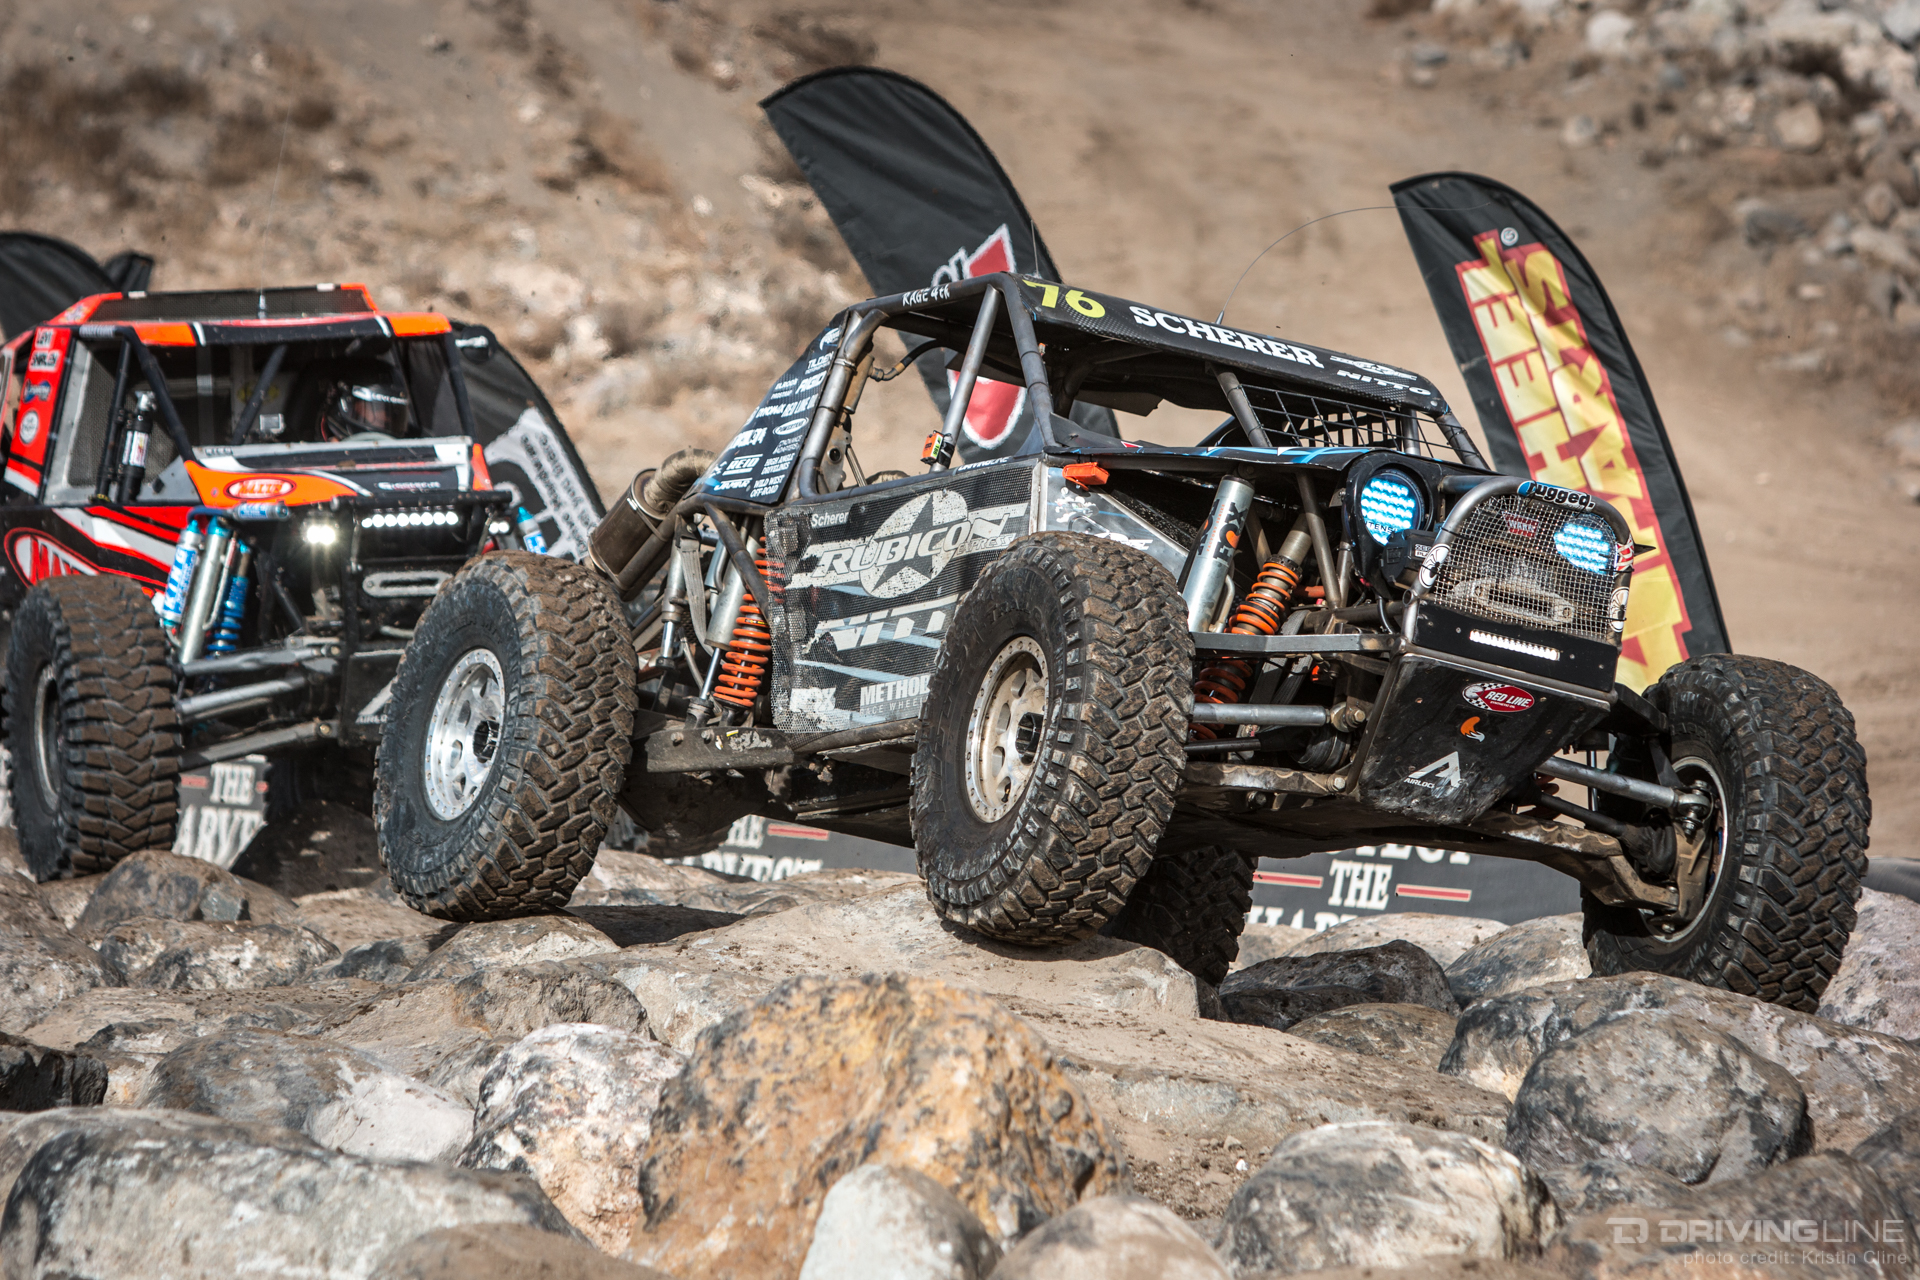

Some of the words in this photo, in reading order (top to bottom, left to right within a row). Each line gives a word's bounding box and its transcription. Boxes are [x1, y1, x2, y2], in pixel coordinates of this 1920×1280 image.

[902, 287, 929, 307] RAGE
[1022, 279, 1106, 318] 76
[1129, 305, 1325, 369] SCHERER
[1462, 238, 1585, 491] HEEL
[1337, 370, 1431, 395] NITTO
[726, 457, 760, 470] REID
[754, 478, 769, 488] WILD
[769, 474, 785, 485] WEST
[811, 512, 849, 528] Scherer
[1206, 526, 1217, 551] FACTORY
[1216, 504, 1225, 523] SERIES
[1213, 502, 1248, 561] FOX
[1508, 521, 1536, 532] WARN
[811, 513, 1009, 578] RUBICON
[958, 533, 1015, 555] EXPRESS
[165, 548, 188, 611] KING
[861, 674, 931, 706] METHOD
[1485, 691, 1508, 702] RED
[1506, 696, 1532, 707] LINE
[210, 761, 256, 804] THE
[726, 814, 766, 849] HE
[1328, 858, 1393, 910] THE
